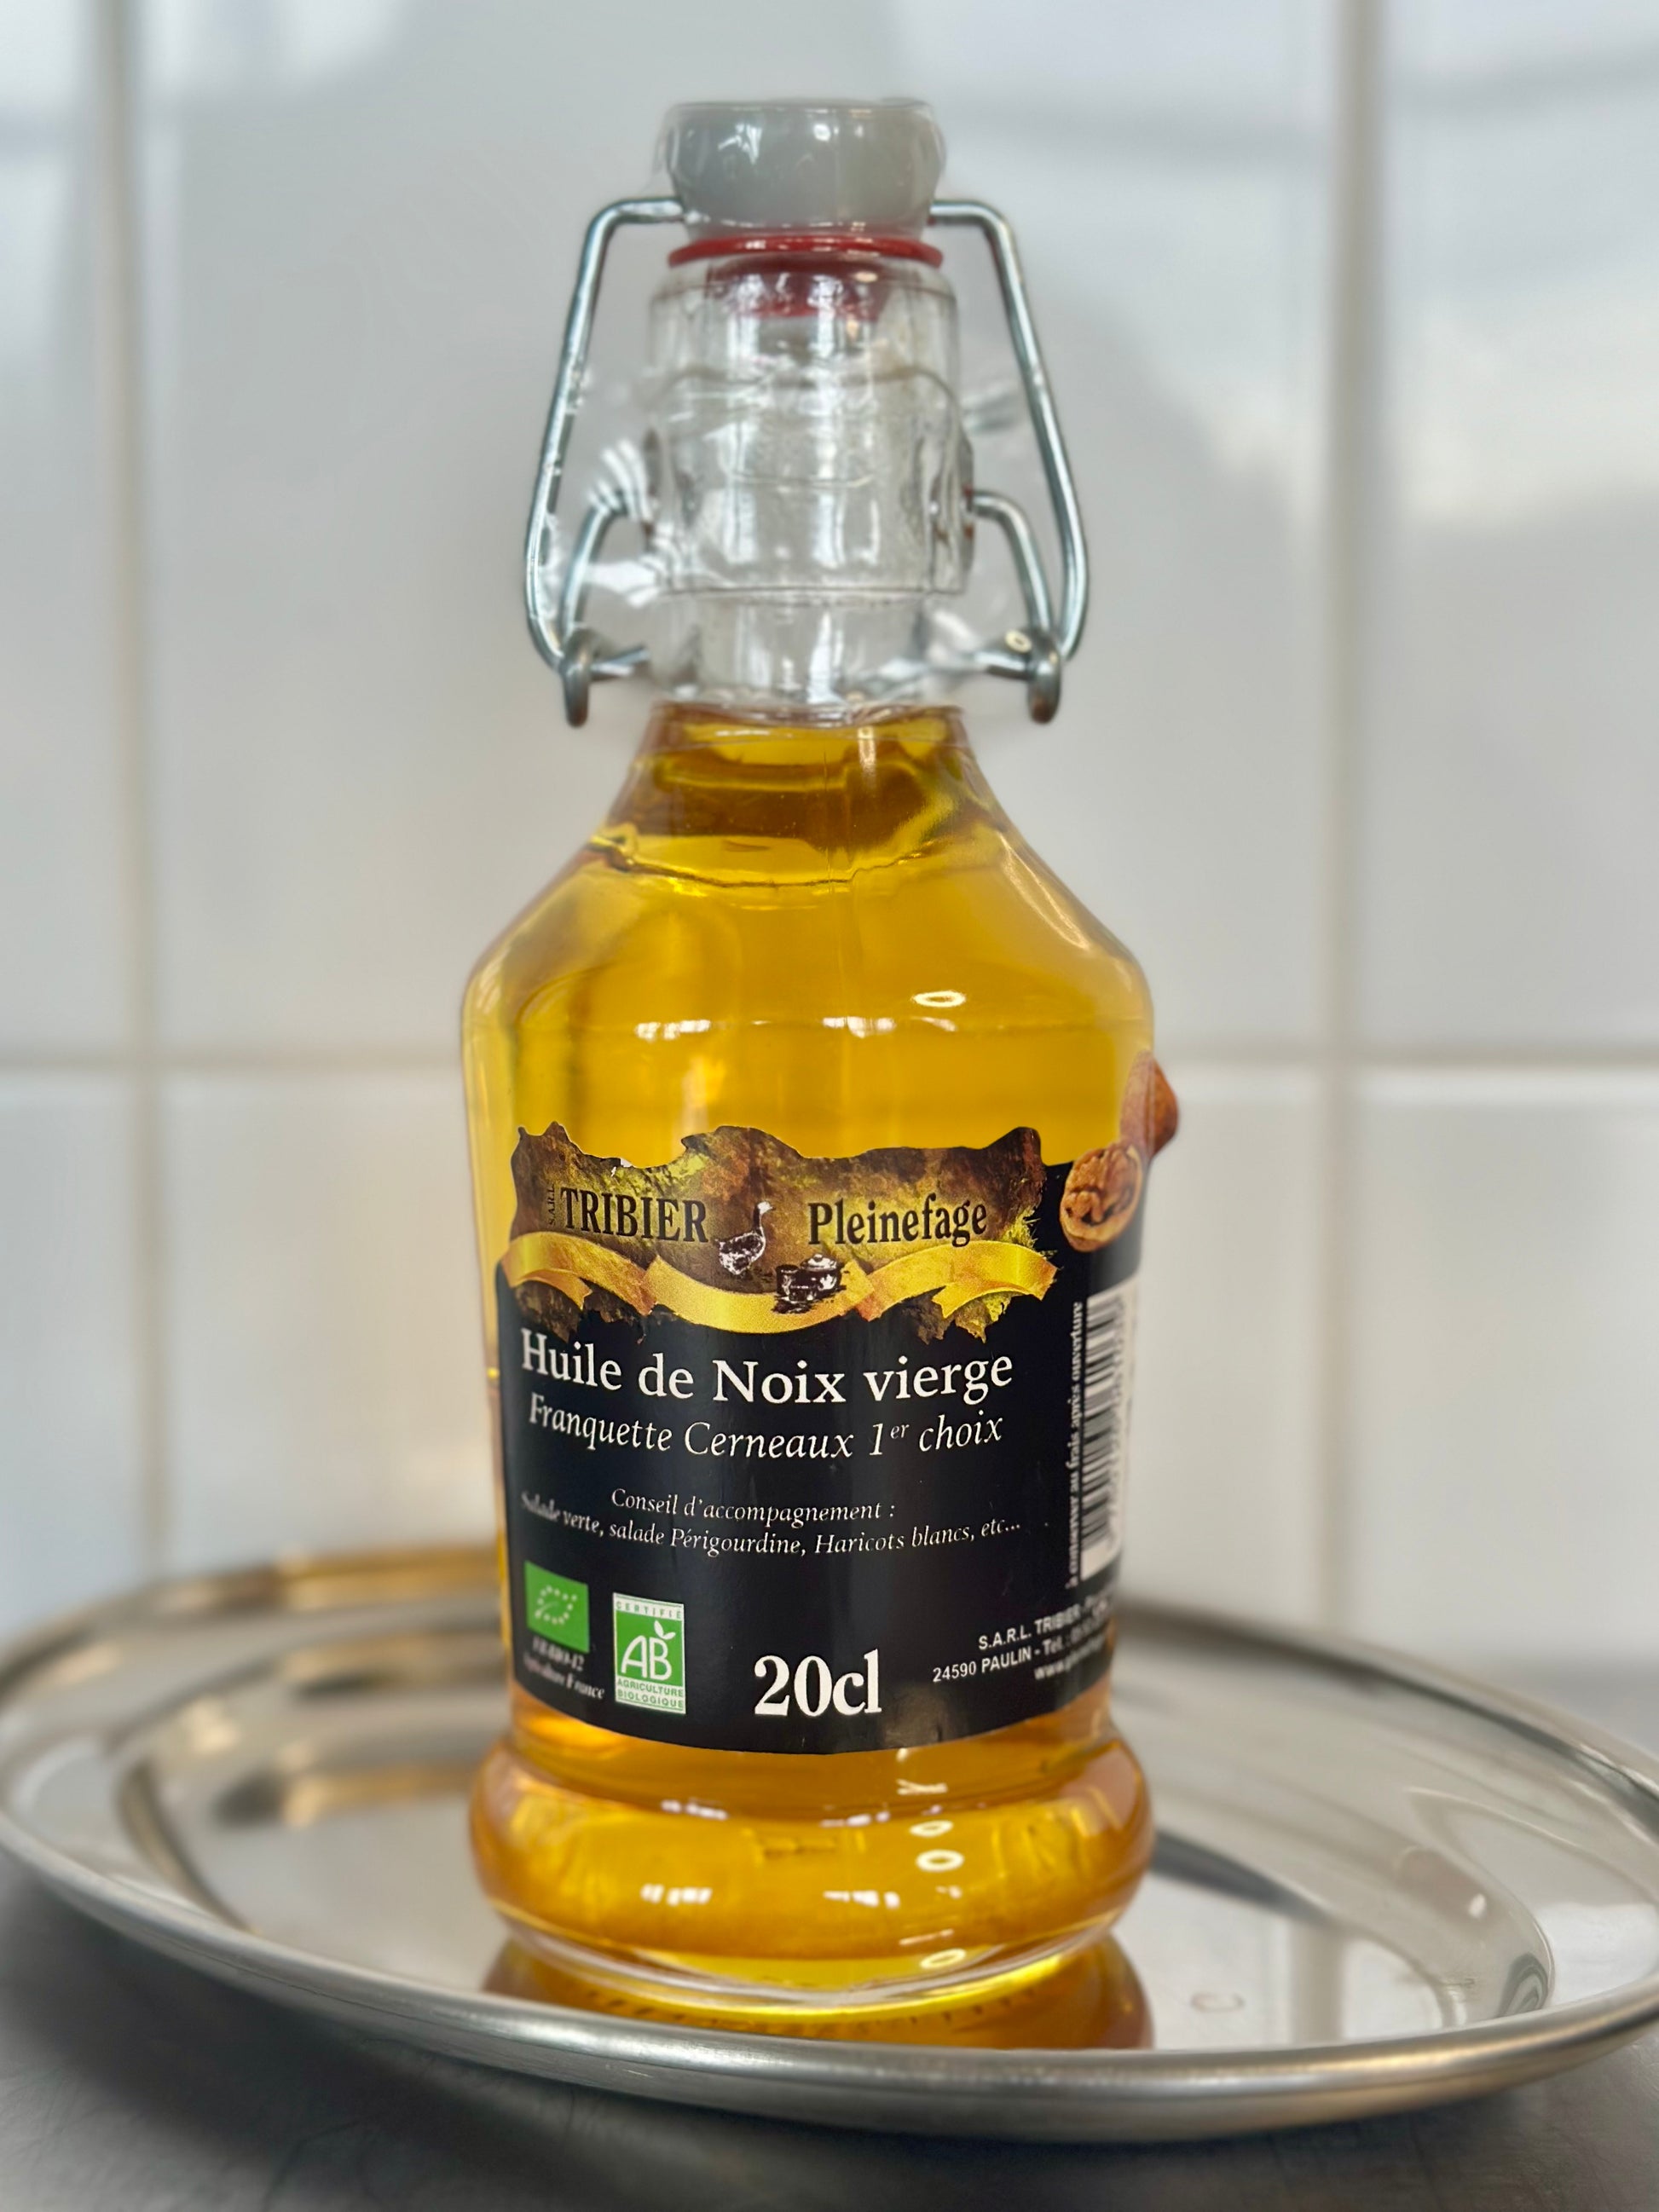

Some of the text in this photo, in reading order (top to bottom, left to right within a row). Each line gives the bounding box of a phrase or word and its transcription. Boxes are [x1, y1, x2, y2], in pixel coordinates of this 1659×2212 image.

[559, 1187, 708, 1244] TRIBIER
[808, 1193, 987, 1248] Pleinefage
[1070, 1302, 1083, 1382] ouverture
[521, 1328, 1013, 1405] Huile de Noix vierge
[529, 1392, 673, 1451] Franquette
[685, 1422, 854, 1459] Cerneaux
[918, 1410, 1003, 1450] choix
[611, 1488, 679, 1515] Conseil
[563, 1510, 604, 1538] verte,
[609, 1520, 665, 1545] salade
[670, 1528, 806, 1557] Périgourdine,
[815, 1532, 905, 1554] Haricots
[911, 1525, 975, 1549] blancs,
[621, 1635, 673, 1681] AB
[979, 1625, 1032, 1650] S.A.R.L.
[617, 1678, 684, 1697] AGRICULTURE
[754, 1649, 882, 1717] 20cl
[933, 1660, 977, 1683] 24590
[981, 1645, 1032, 1673] PAULIN
[617, 1689, 684, 1708] BIOLOGIQUE
